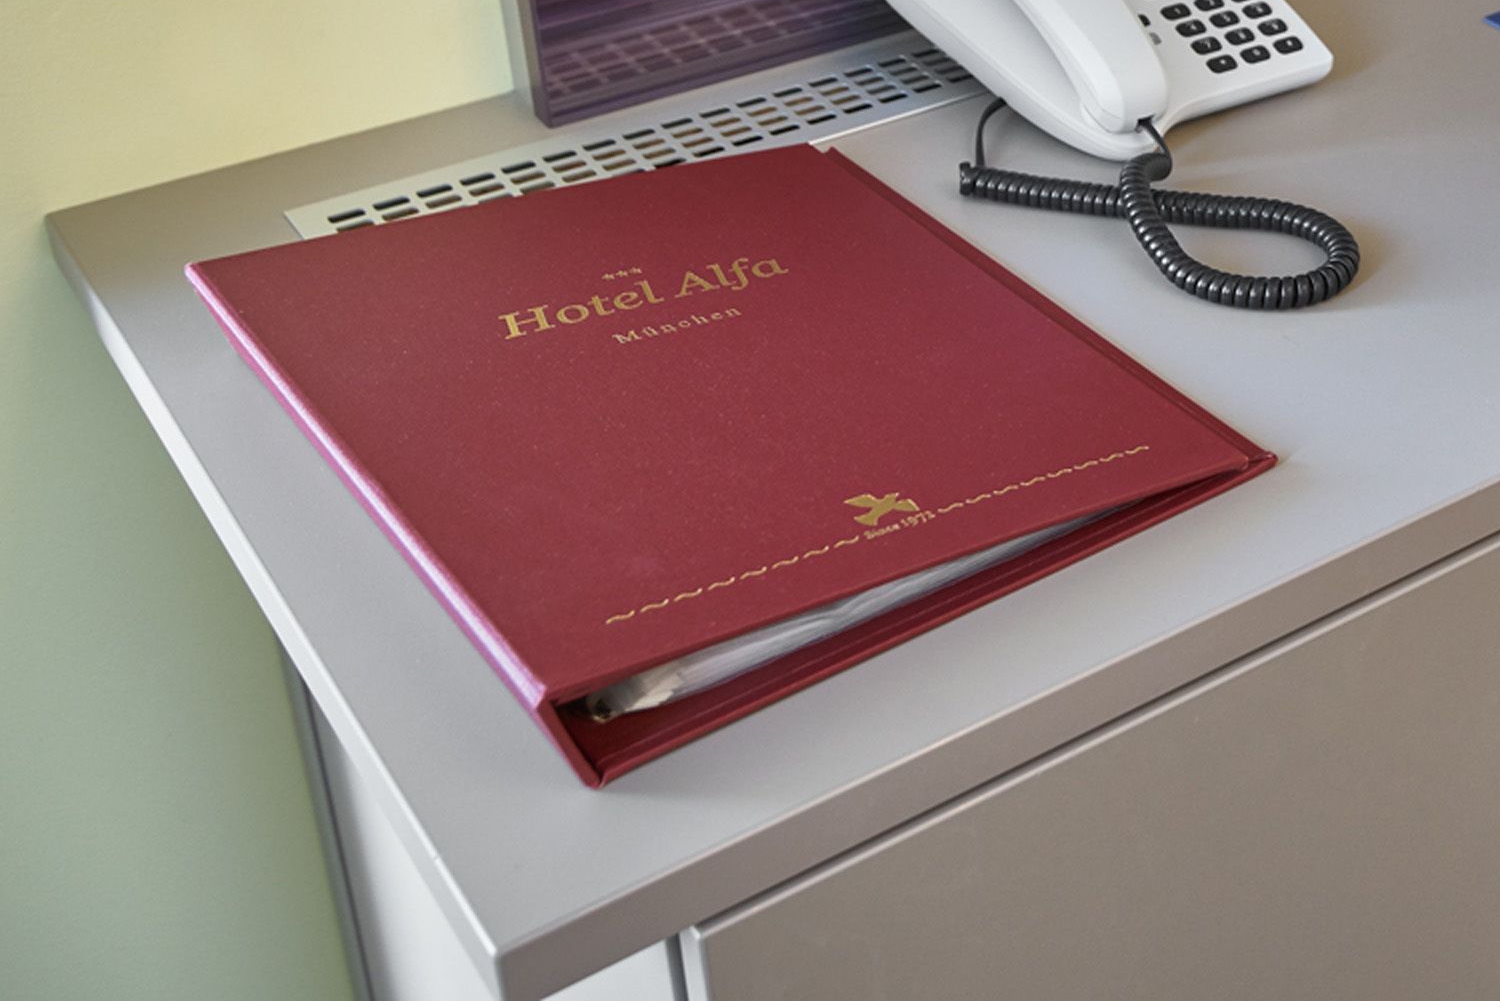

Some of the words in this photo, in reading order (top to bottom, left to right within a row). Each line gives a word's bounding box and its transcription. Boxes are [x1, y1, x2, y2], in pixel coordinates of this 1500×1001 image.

[498, 280, 664, 340] Hotel
[675, 257, 789, 298] Alfa
[612, 306, 742, 344] München
